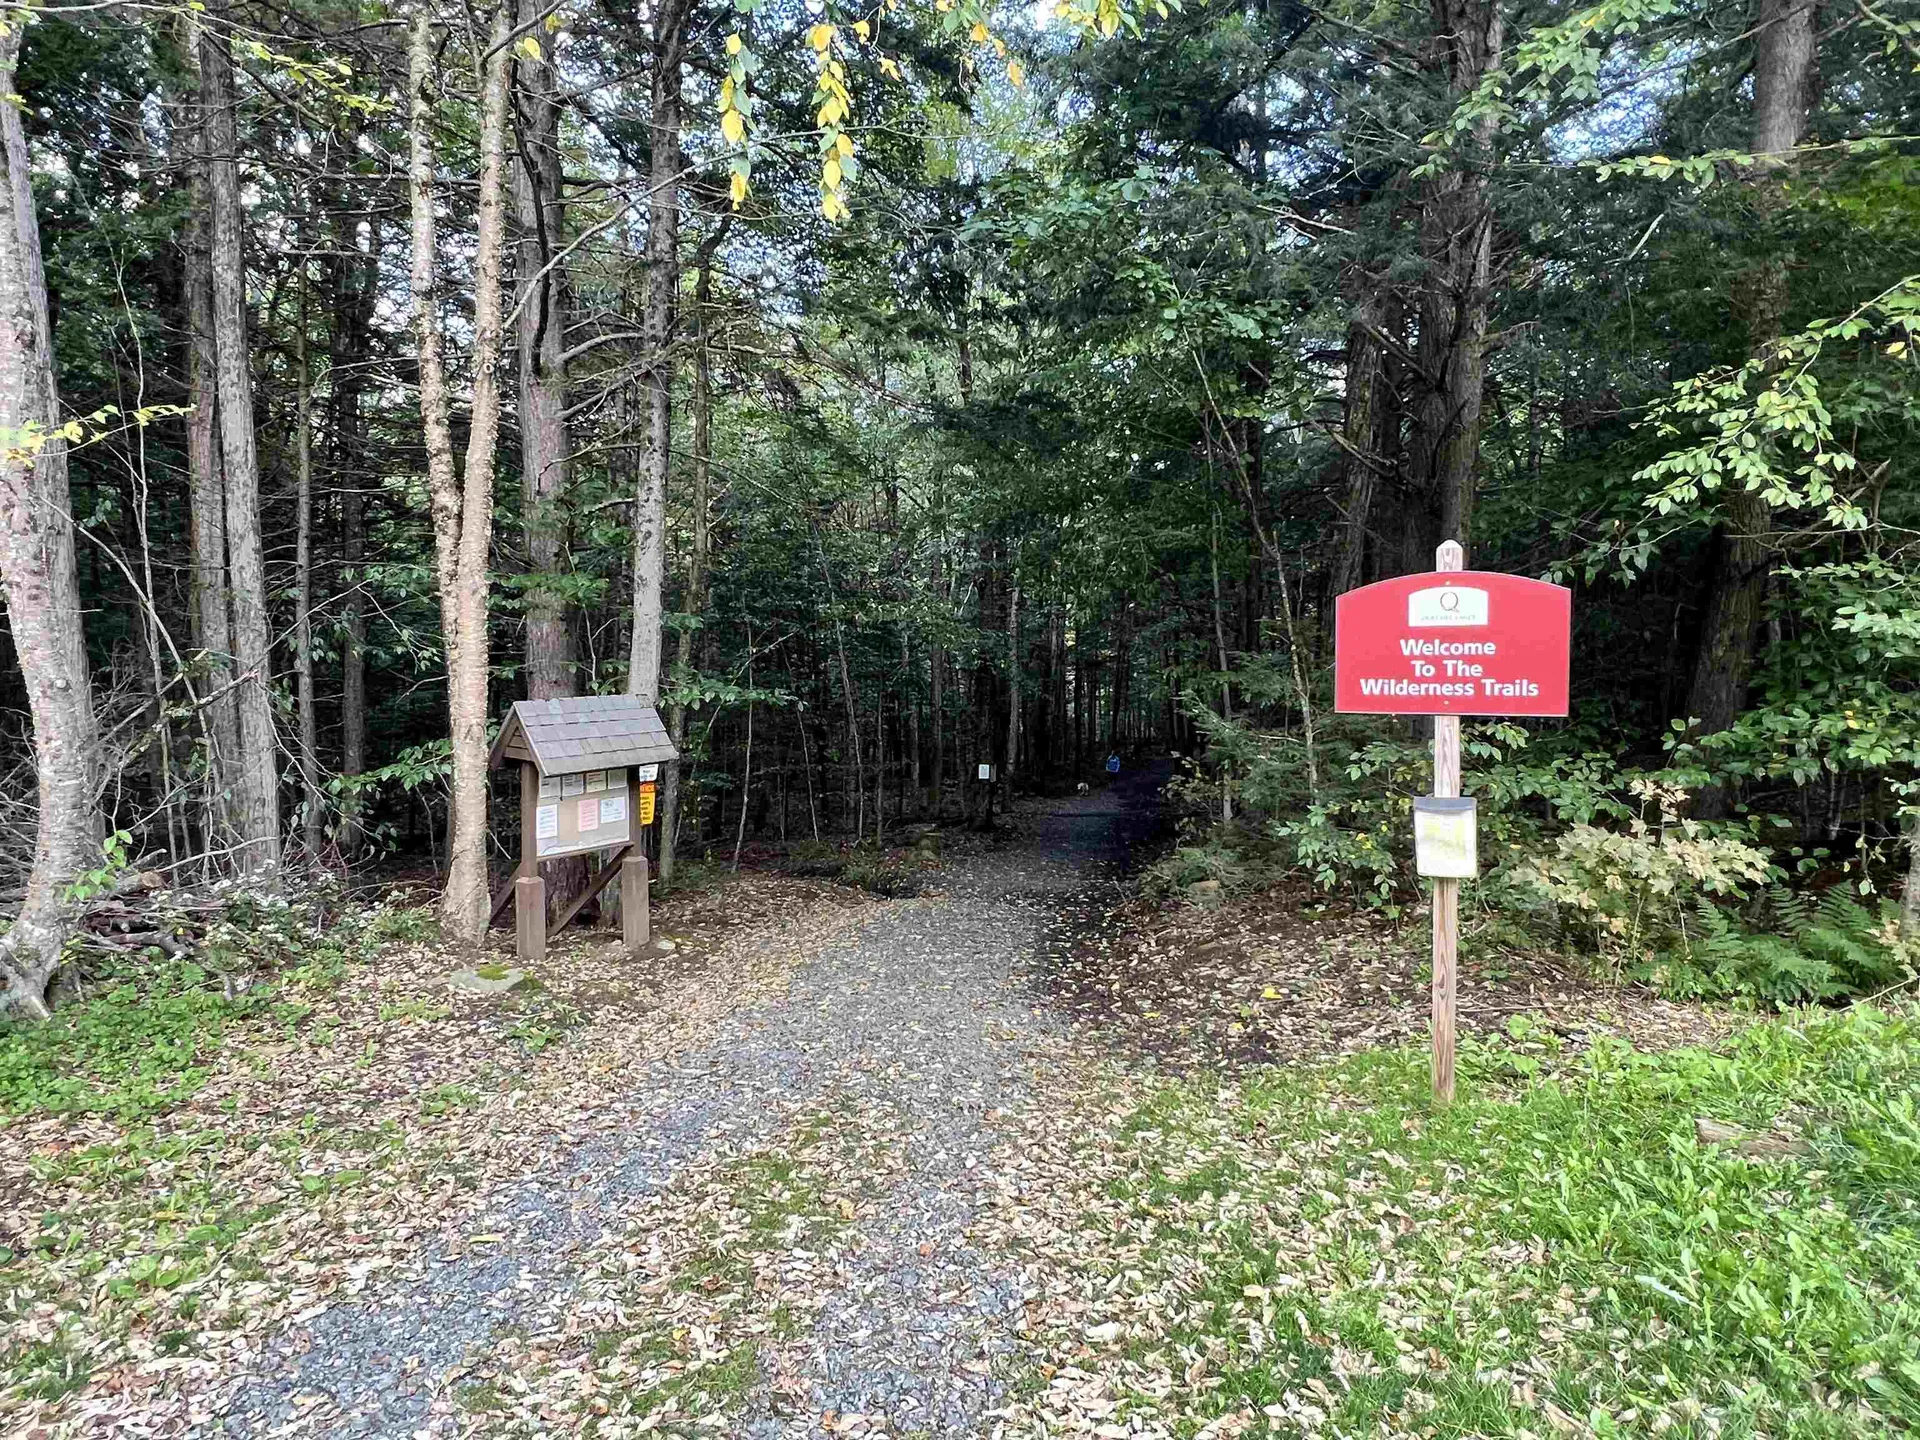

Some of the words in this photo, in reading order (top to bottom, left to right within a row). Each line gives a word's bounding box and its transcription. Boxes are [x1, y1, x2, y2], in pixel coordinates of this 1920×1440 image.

[1440, 591, 1460, 612] Q
[1400, 639, 1496, 656] Welcome
[1411, 660, 1436, 677] To
[1443, 659, 1483, 677] The
[1360, 679, 1474, 696] Wilderness
[1481, 680, 1539, 697] Trails
